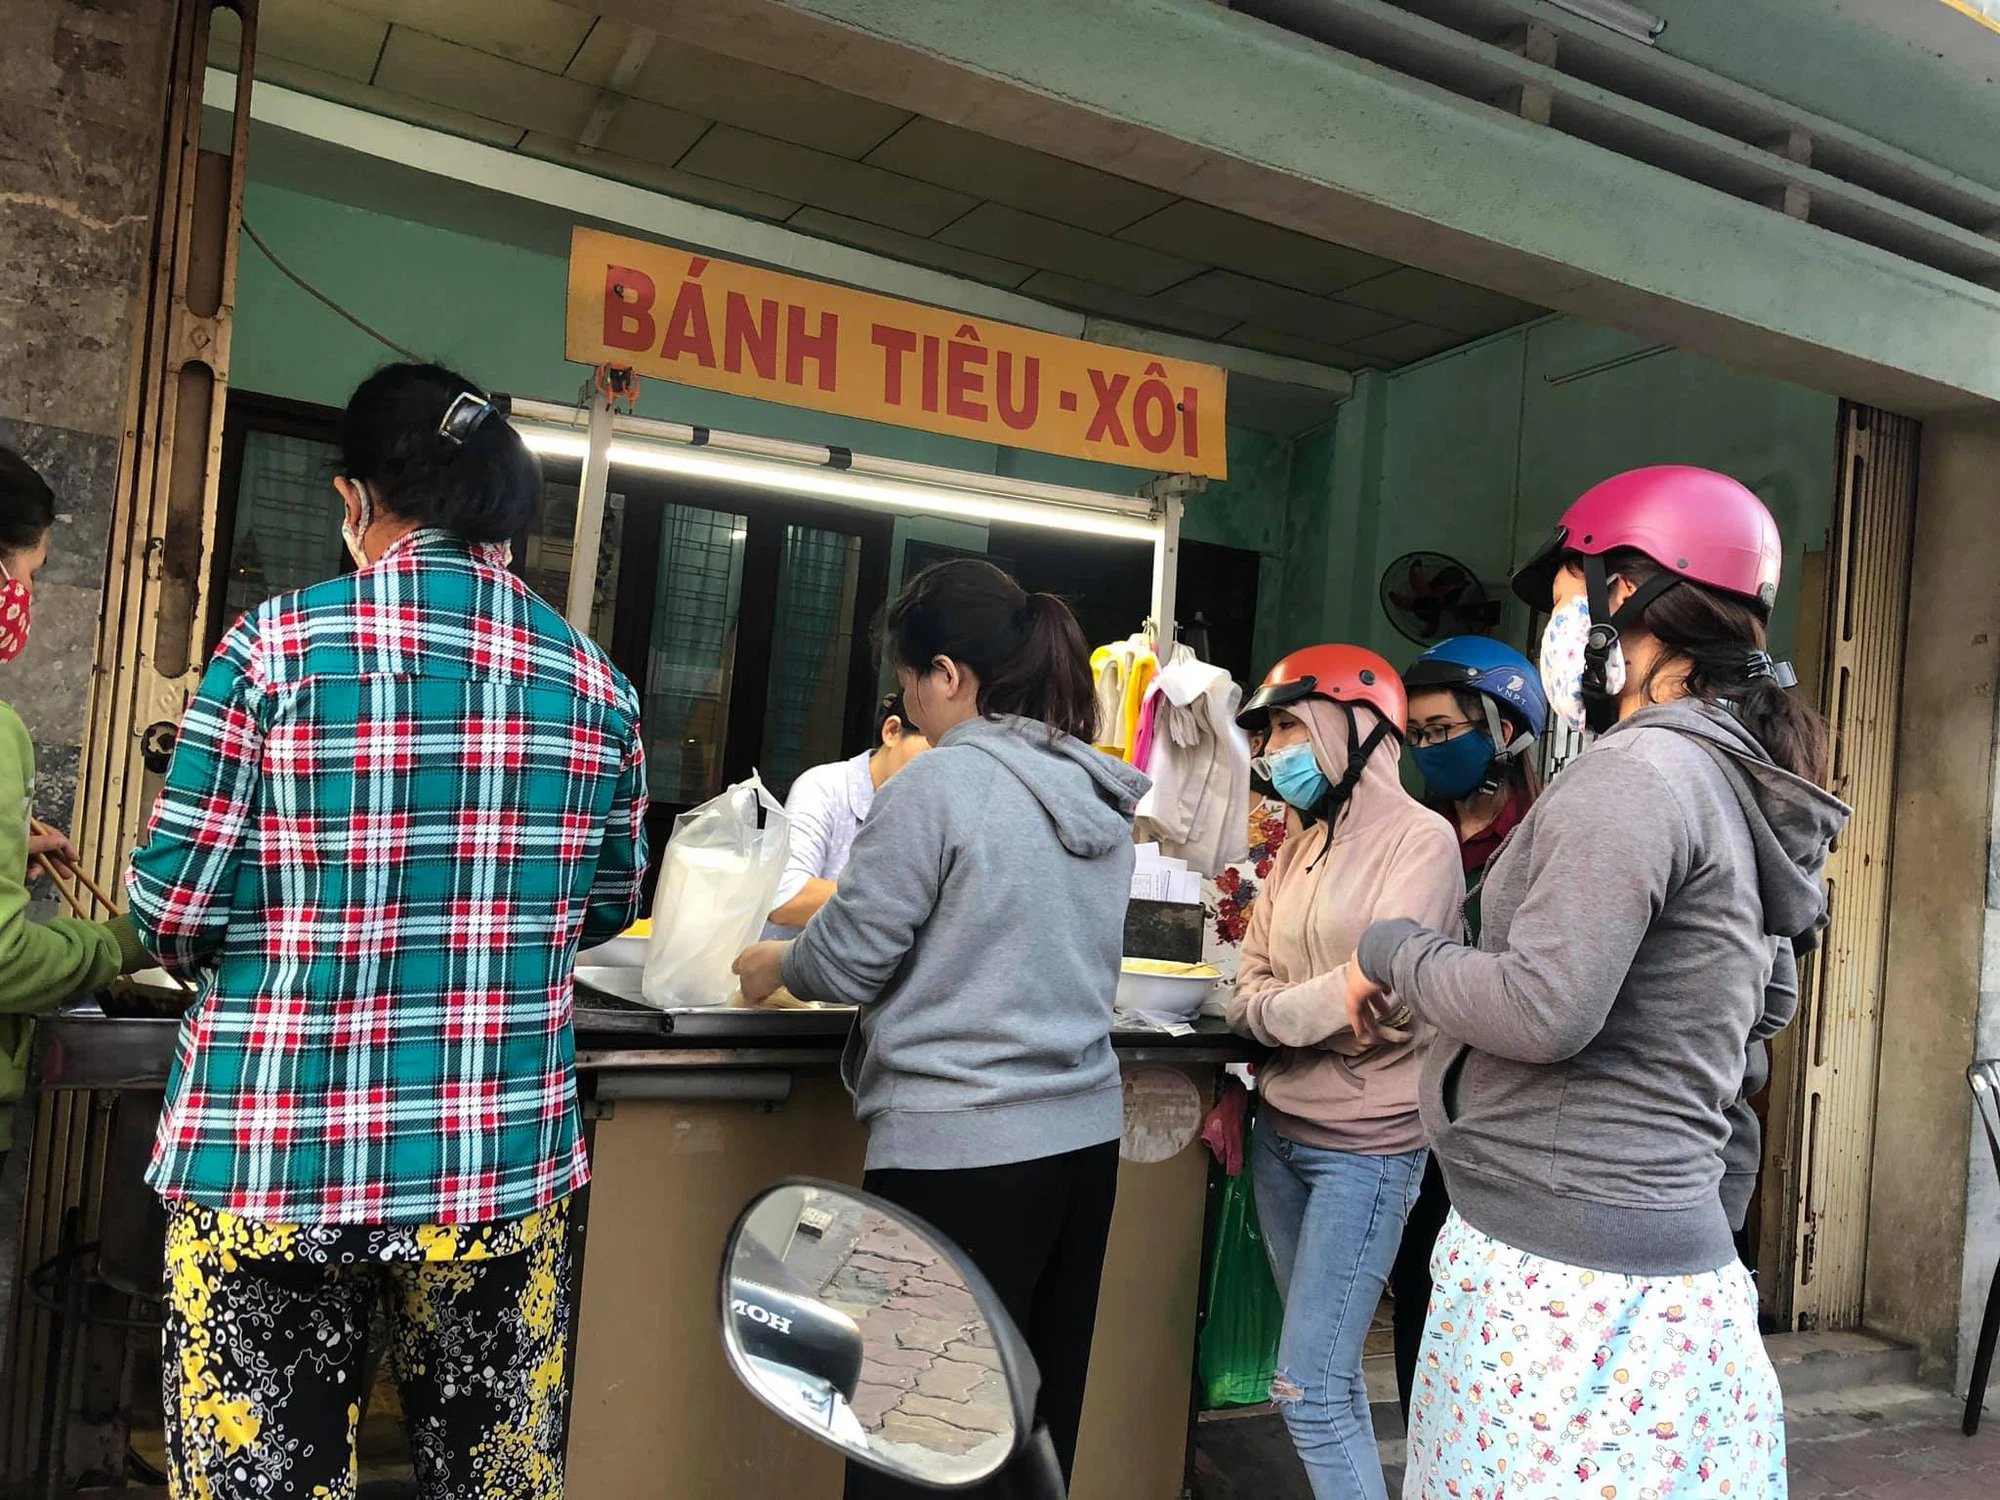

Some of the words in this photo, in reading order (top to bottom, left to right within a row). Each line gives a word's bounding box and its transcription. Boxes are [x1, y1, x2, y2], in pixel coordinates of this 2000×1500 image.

[603, 257, 838, 392] BÁNH
[871, 323, 1040, 430] TIÊU
[1496, 684, 1527, 705] VNPT
